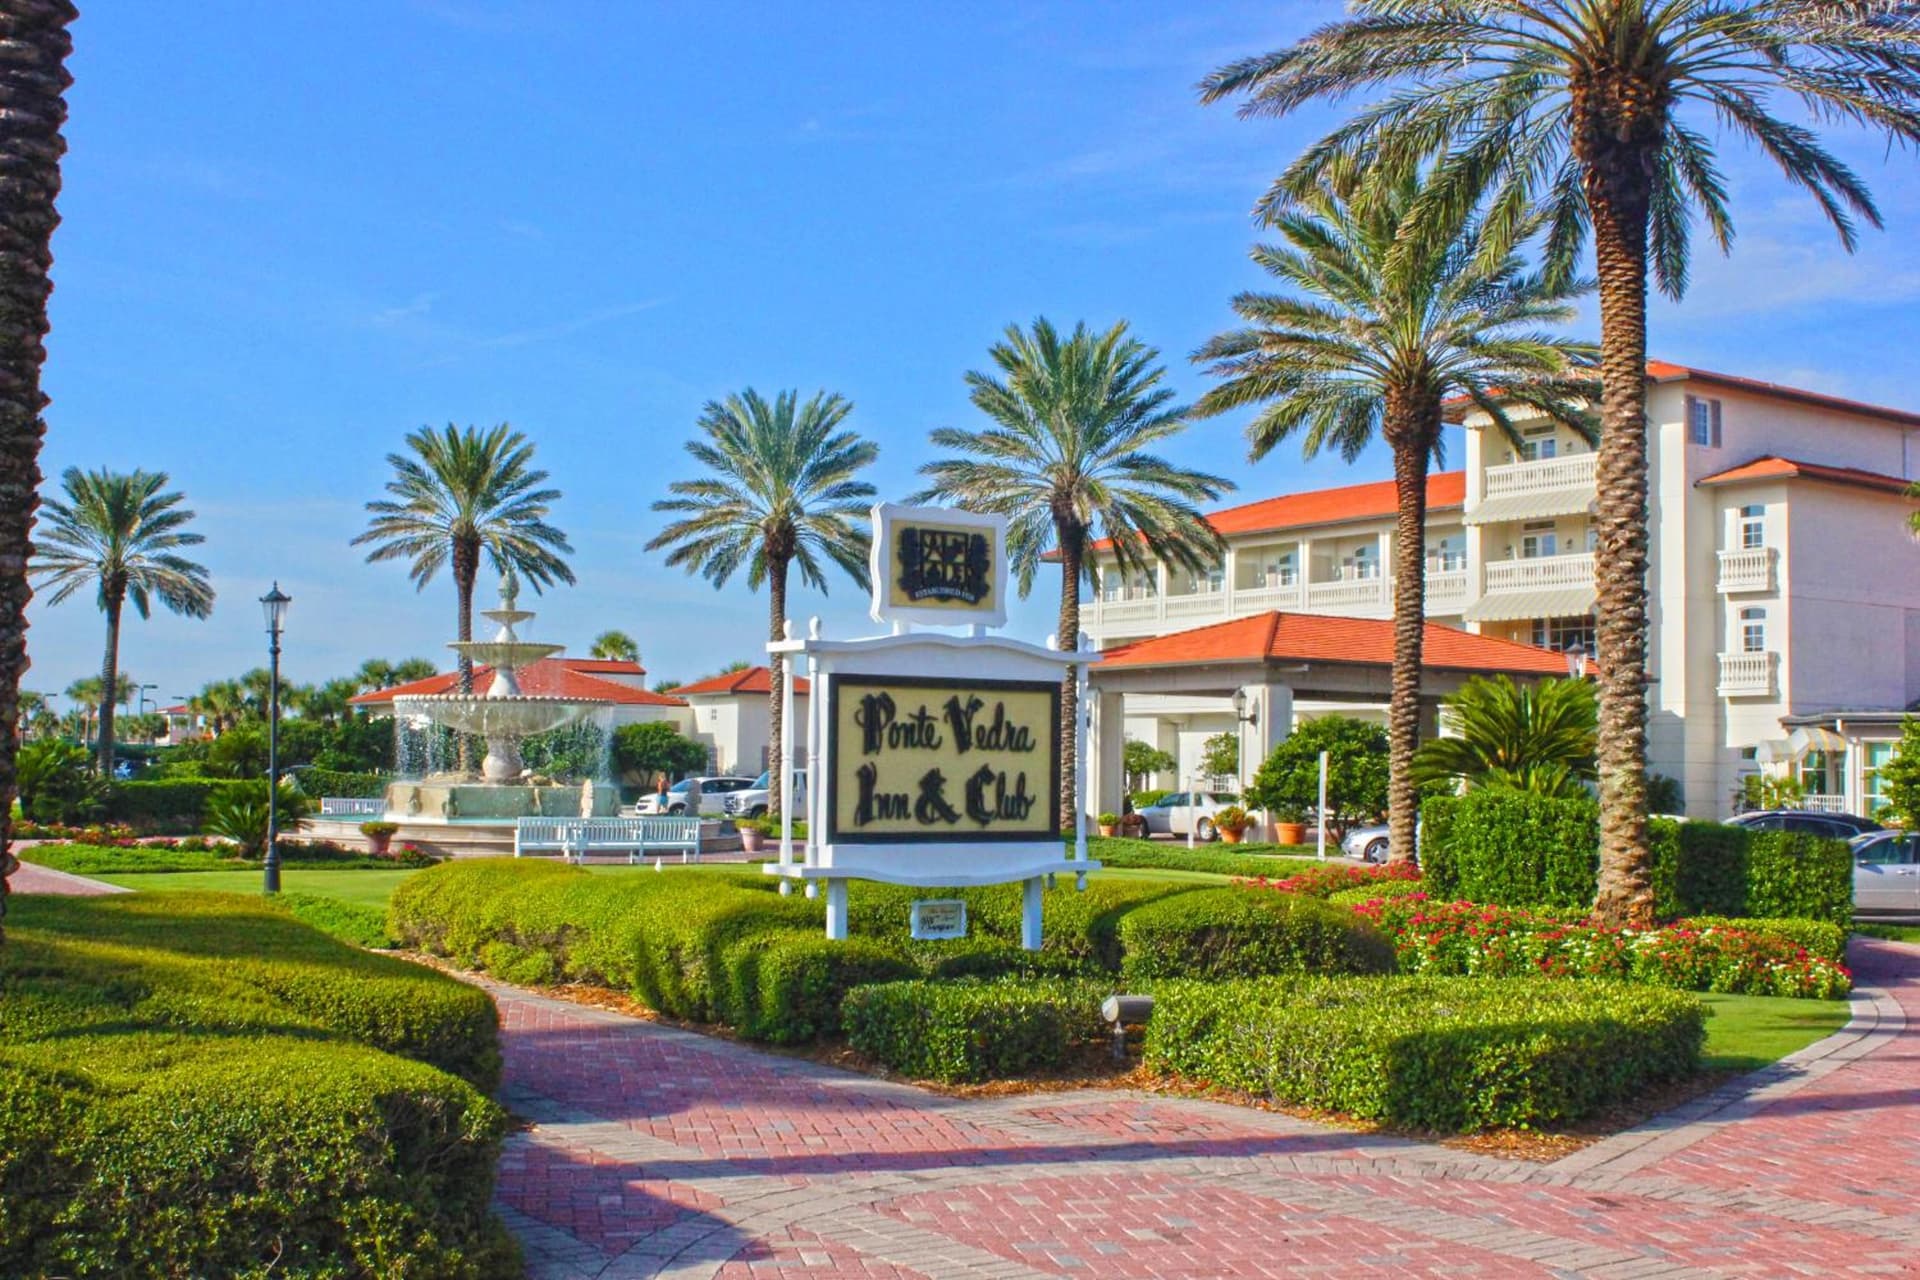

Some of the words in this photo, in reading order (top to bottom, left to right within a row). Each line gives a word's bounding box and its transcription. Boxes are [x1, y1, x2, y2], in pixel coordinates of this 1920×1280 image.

[855, 691, 943, 755] Ponte
[943, 694, 1036, 755] Vedra
[854, 762, 911, 826] Inn
[915, 767, 961, 825] &
[965, 763, 1036, 827] Club
